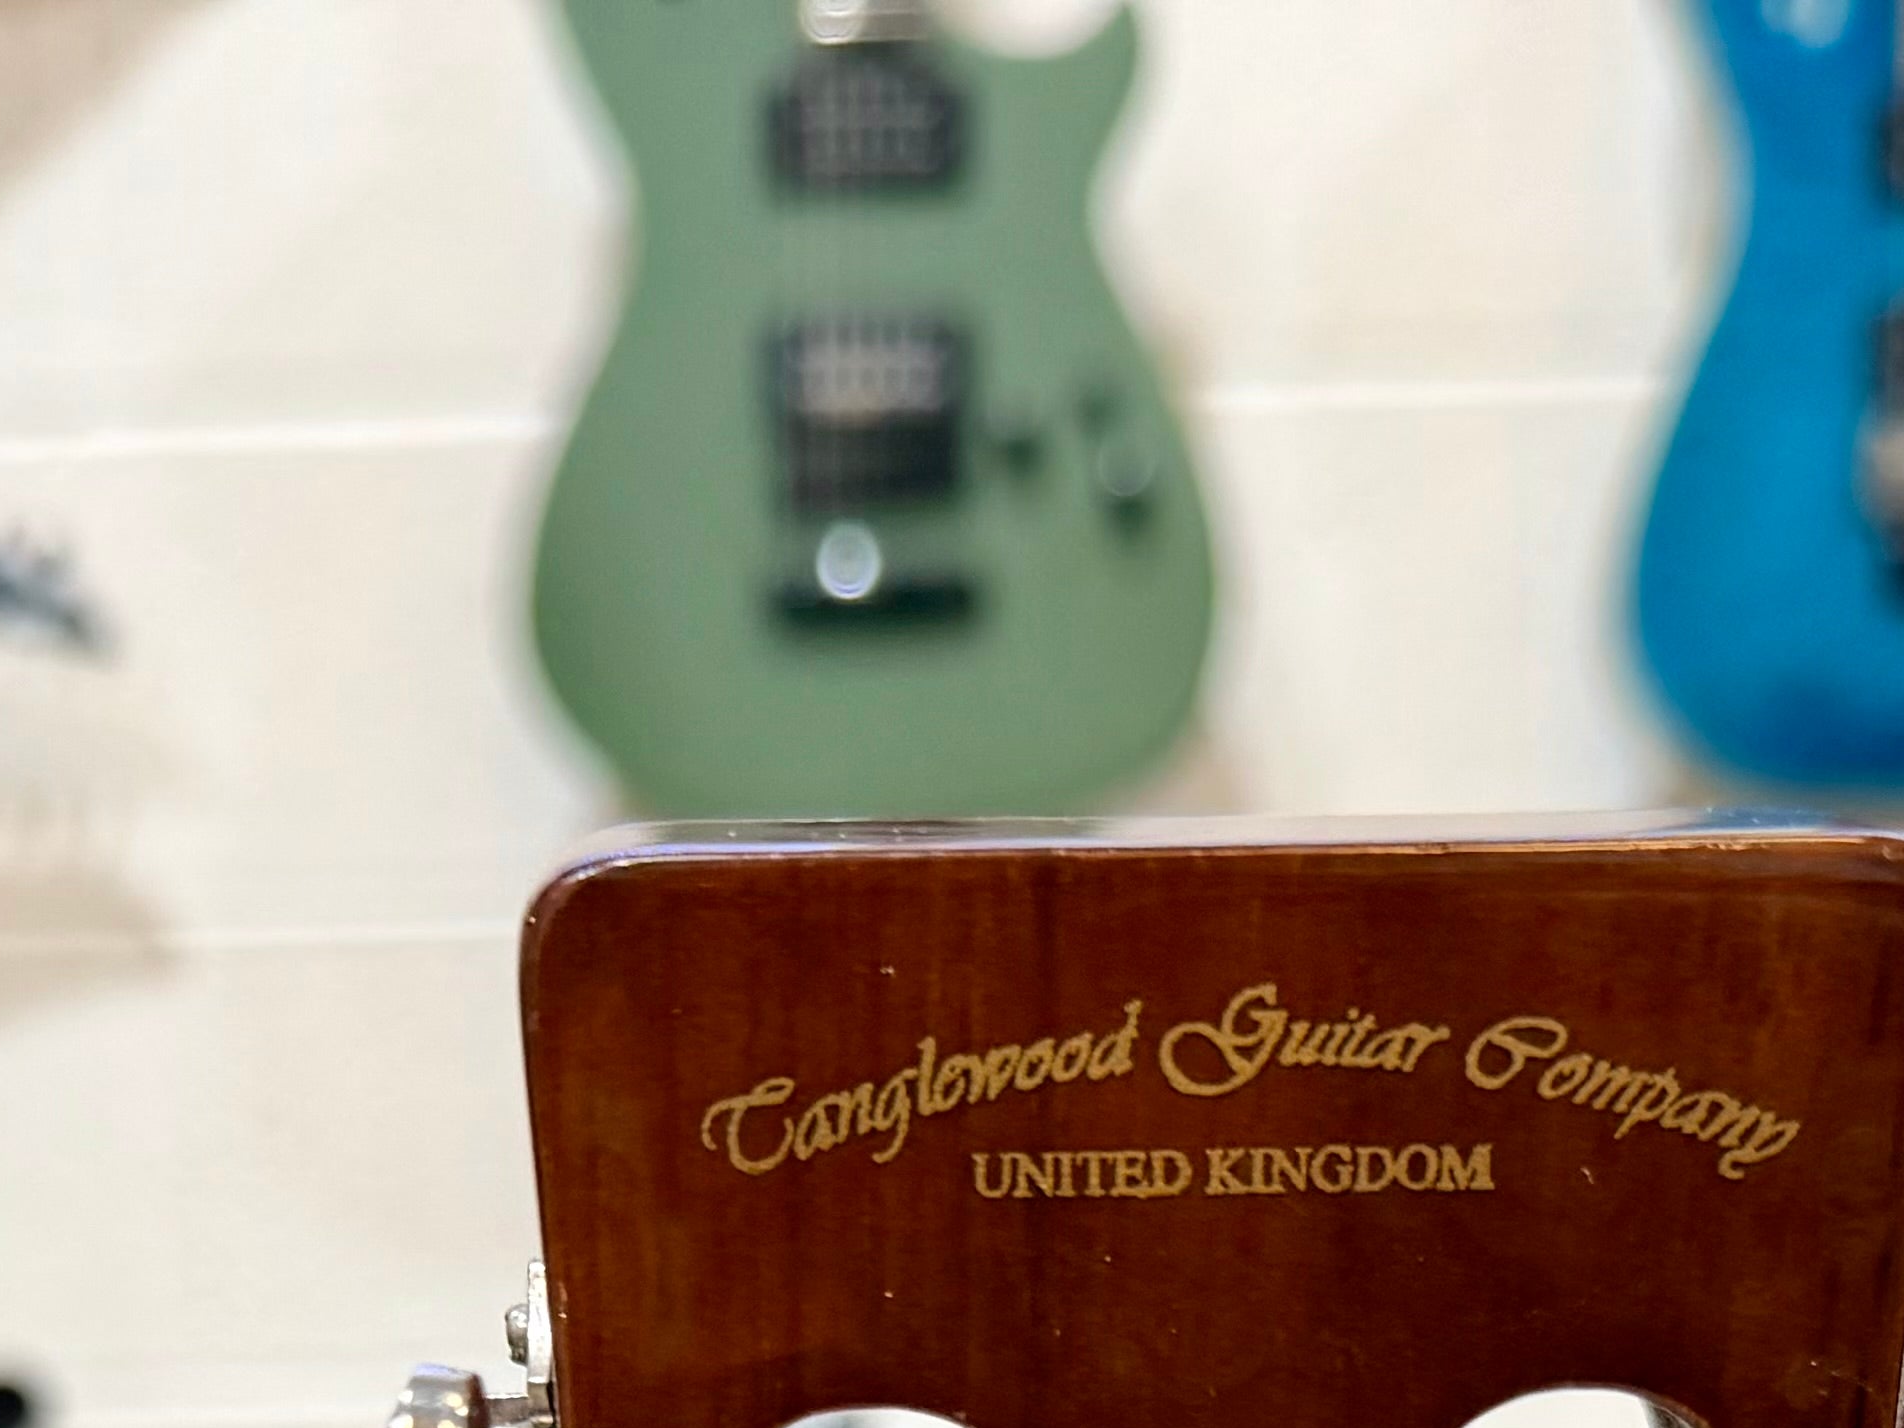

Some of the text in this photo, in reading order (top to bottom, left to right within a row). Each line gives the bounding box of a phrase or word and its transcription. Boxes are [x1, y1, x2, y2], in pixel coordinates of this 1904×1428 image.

[700, 982, 1801, 1180] Tanglewood Guitar Company
[971, 1143, 1495, 1199] UNITED KINGDOM
